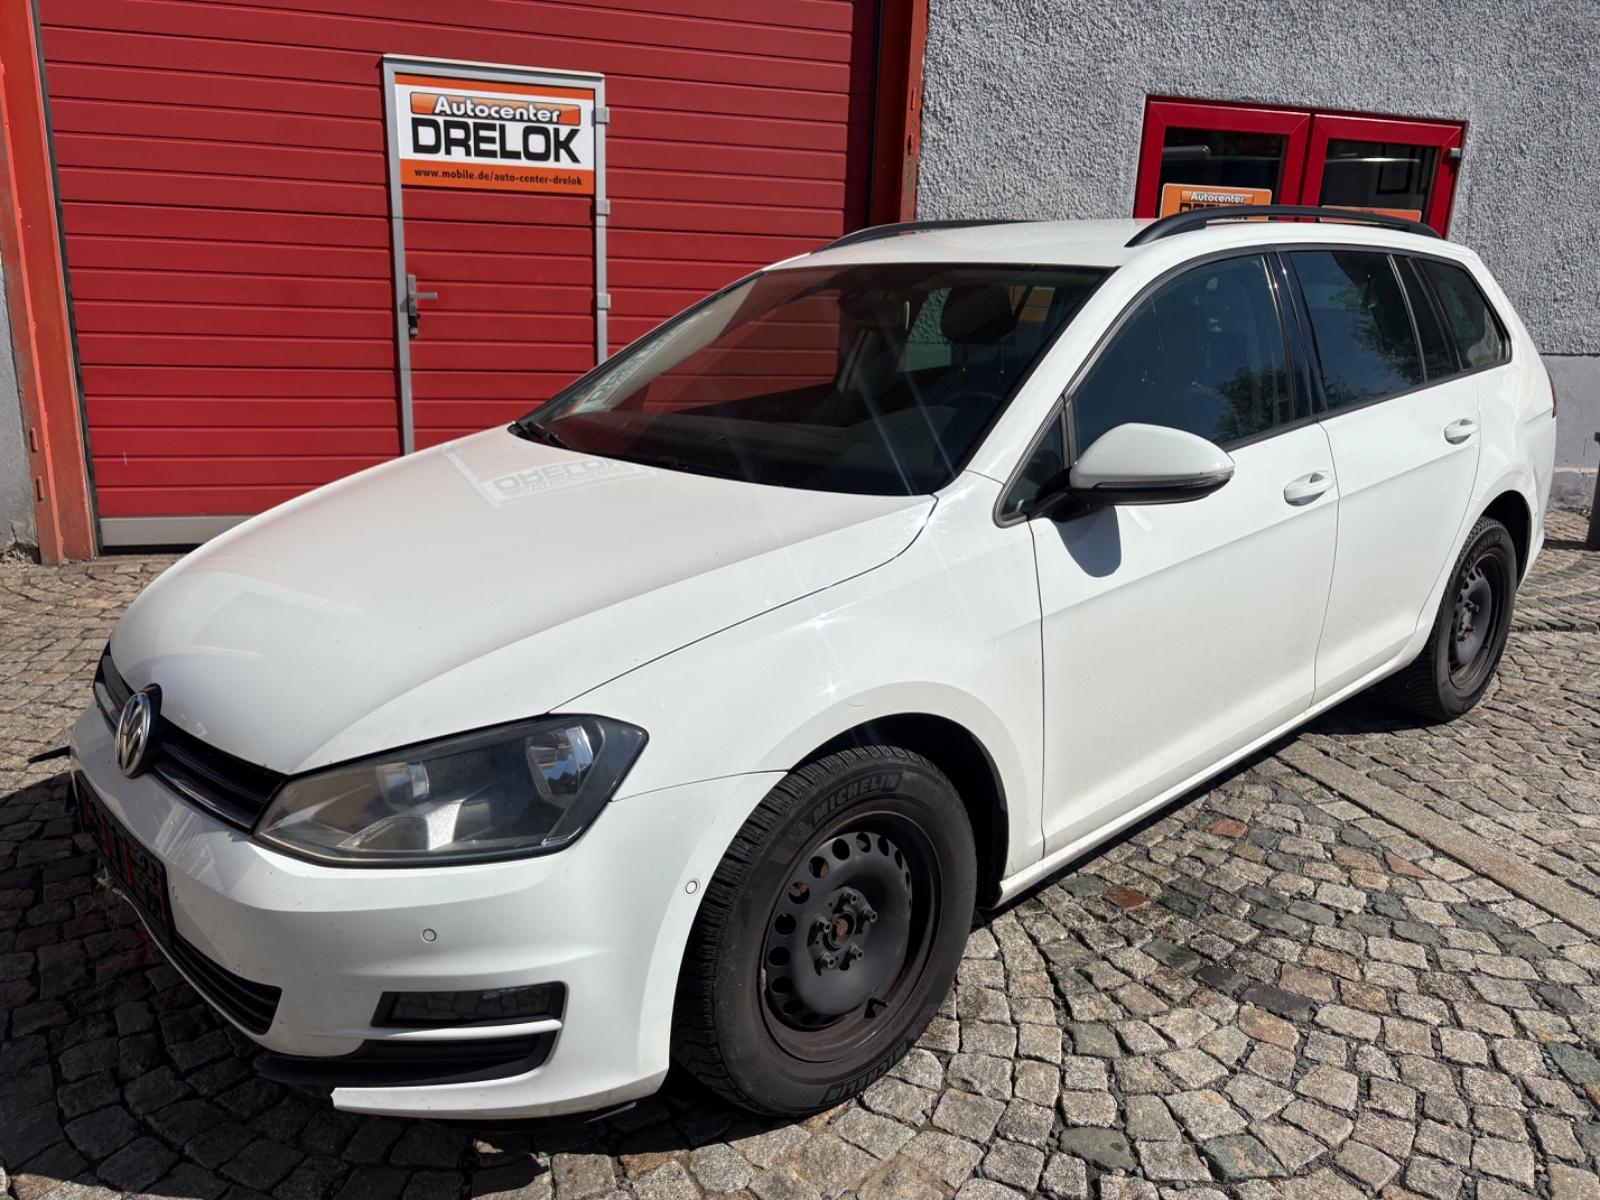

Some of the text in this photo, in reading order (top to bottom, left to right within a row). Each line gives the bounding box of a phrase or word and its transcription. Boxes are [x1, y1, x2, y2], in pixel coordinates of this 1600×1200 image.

[434, 96, 560, 123] Autocenter
[411, 117, 581, 164] DRELOK
[414, 168, 583, 186] www.mobile.de/auto-center-drelok
[1190, 191, 1245, 204] Autocenter
[812, 773, 901, 824] MICHELIN
